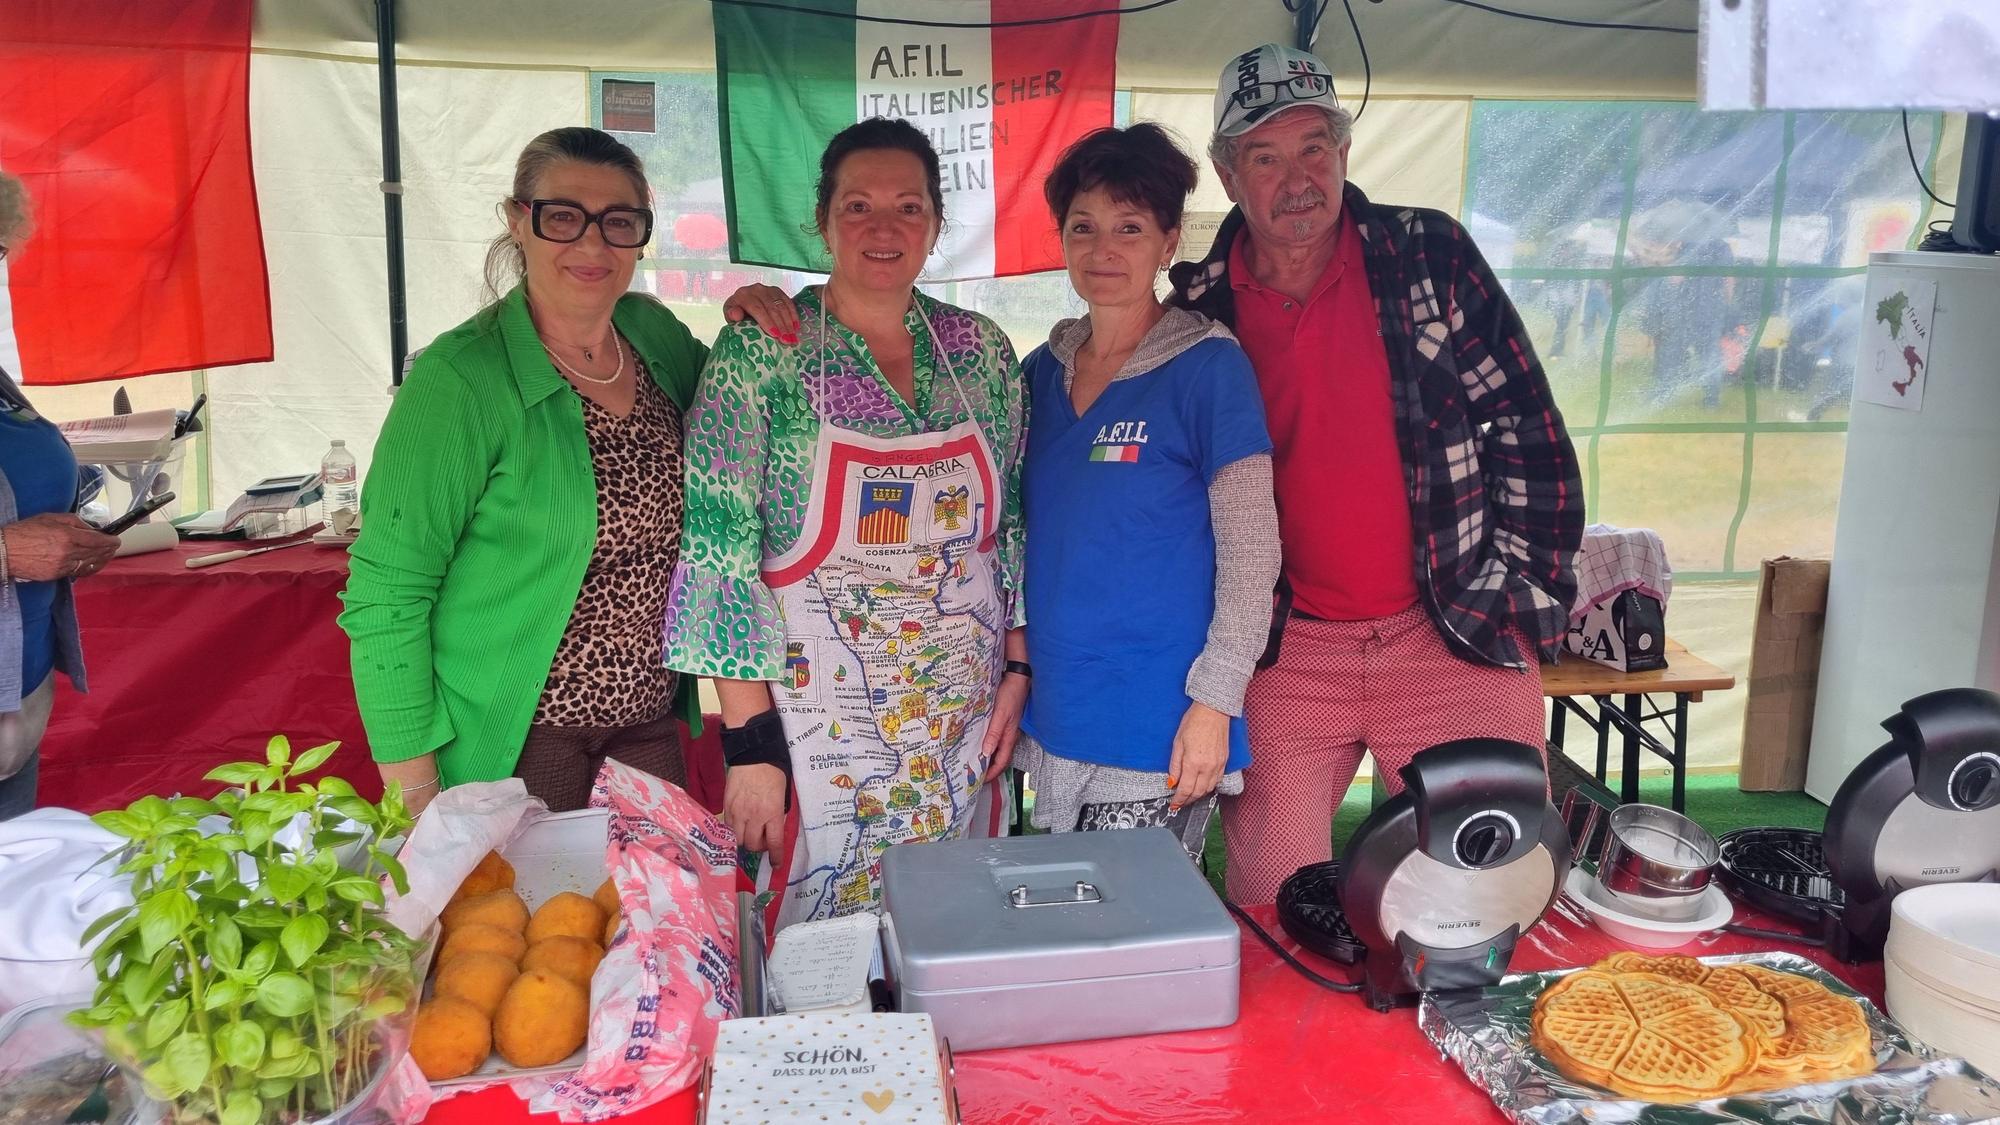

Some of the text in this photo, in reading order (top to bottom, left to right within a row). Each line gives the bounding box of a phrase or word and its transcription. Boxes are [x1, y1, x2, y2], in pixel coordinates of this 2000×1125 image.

[862, 70, 1063, 117] ITALIENISCHER
[929, 118, 1009, 155] ILIEN
[939, 159, 986, 193] EIN
[1906, 307, 1926, 339] ITALIA
[865, 548, 907, 557] COSENZA
[840, 556, 892, 572] BASILICATA
[932, 634, 953, 643] GRECA
[837, 832, 853, 870] MESSINA
[1921, 867, 1960, 876] SEVERIN
[1437, 920, 1481, 930] SEVERIN
[783, 1045, 868, 1064] SCHÖN,
[772, 1064, 877, 1077] DASS DU DA BIST
